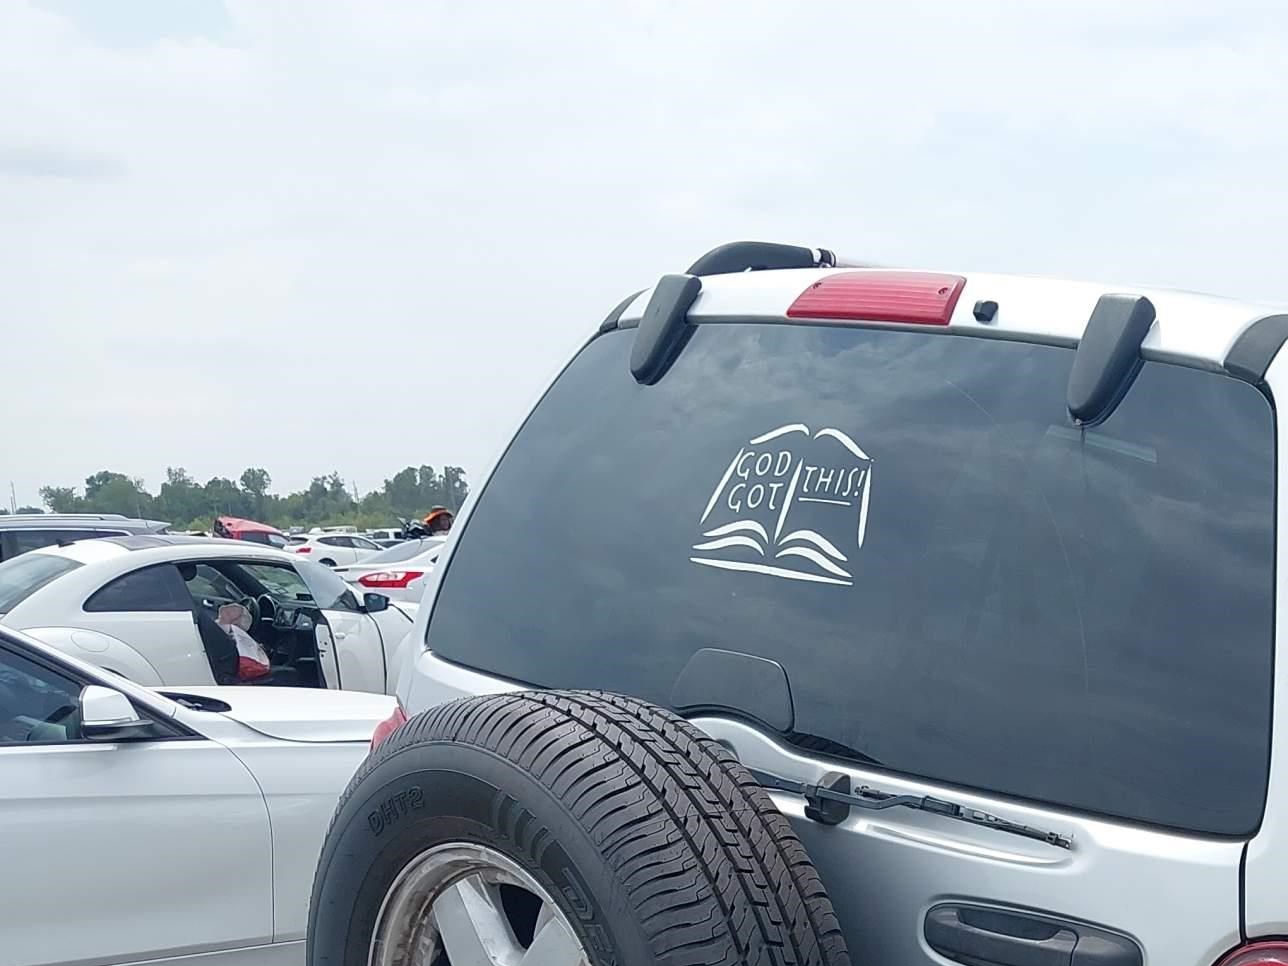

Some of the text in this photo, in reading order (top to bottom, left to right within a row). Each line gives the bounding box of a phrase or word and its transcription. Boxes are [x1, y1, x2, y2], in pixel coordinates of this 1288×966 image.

[736, 450, 792, 480] GOD
[802, 465, 865, 497] THIS!
[727, 482, 784, 513] GOT
